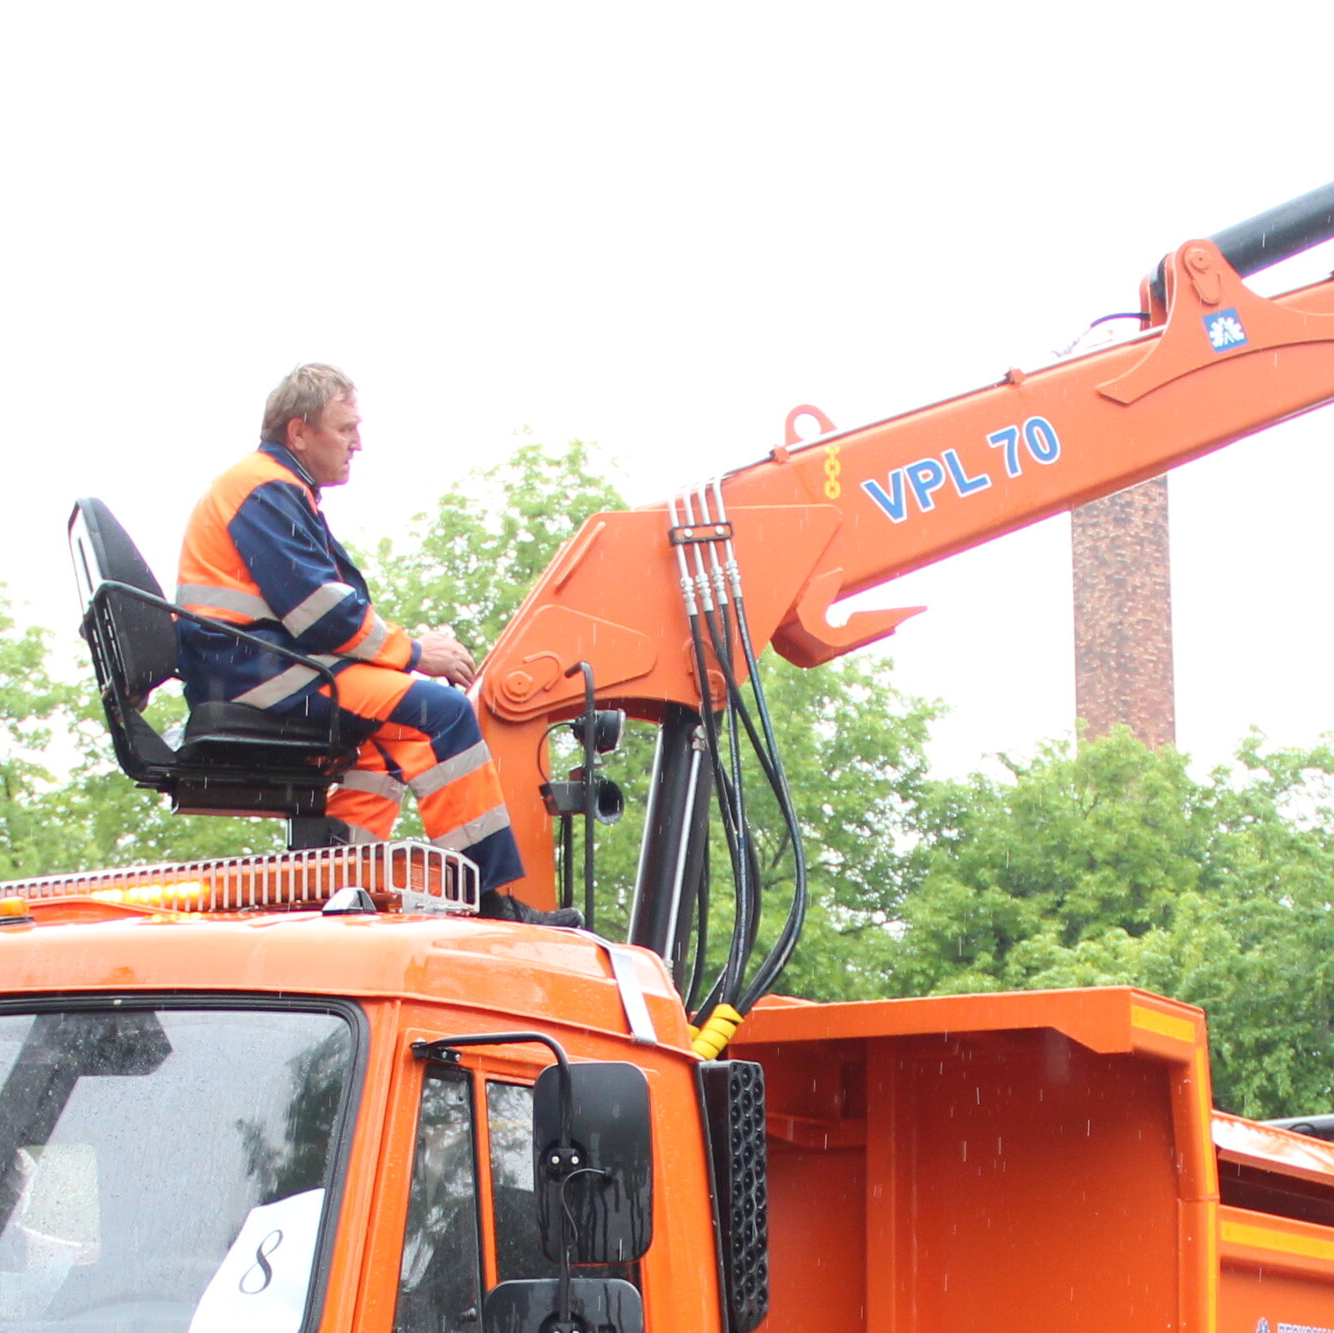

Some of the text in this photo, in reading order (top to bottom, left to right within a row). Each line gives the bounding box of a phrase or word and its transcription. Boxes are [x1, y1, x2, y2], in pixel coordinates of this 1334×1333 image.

[860, 415, 1061, 524] VPL 70
[238, 1228, 283, 1295] 8
